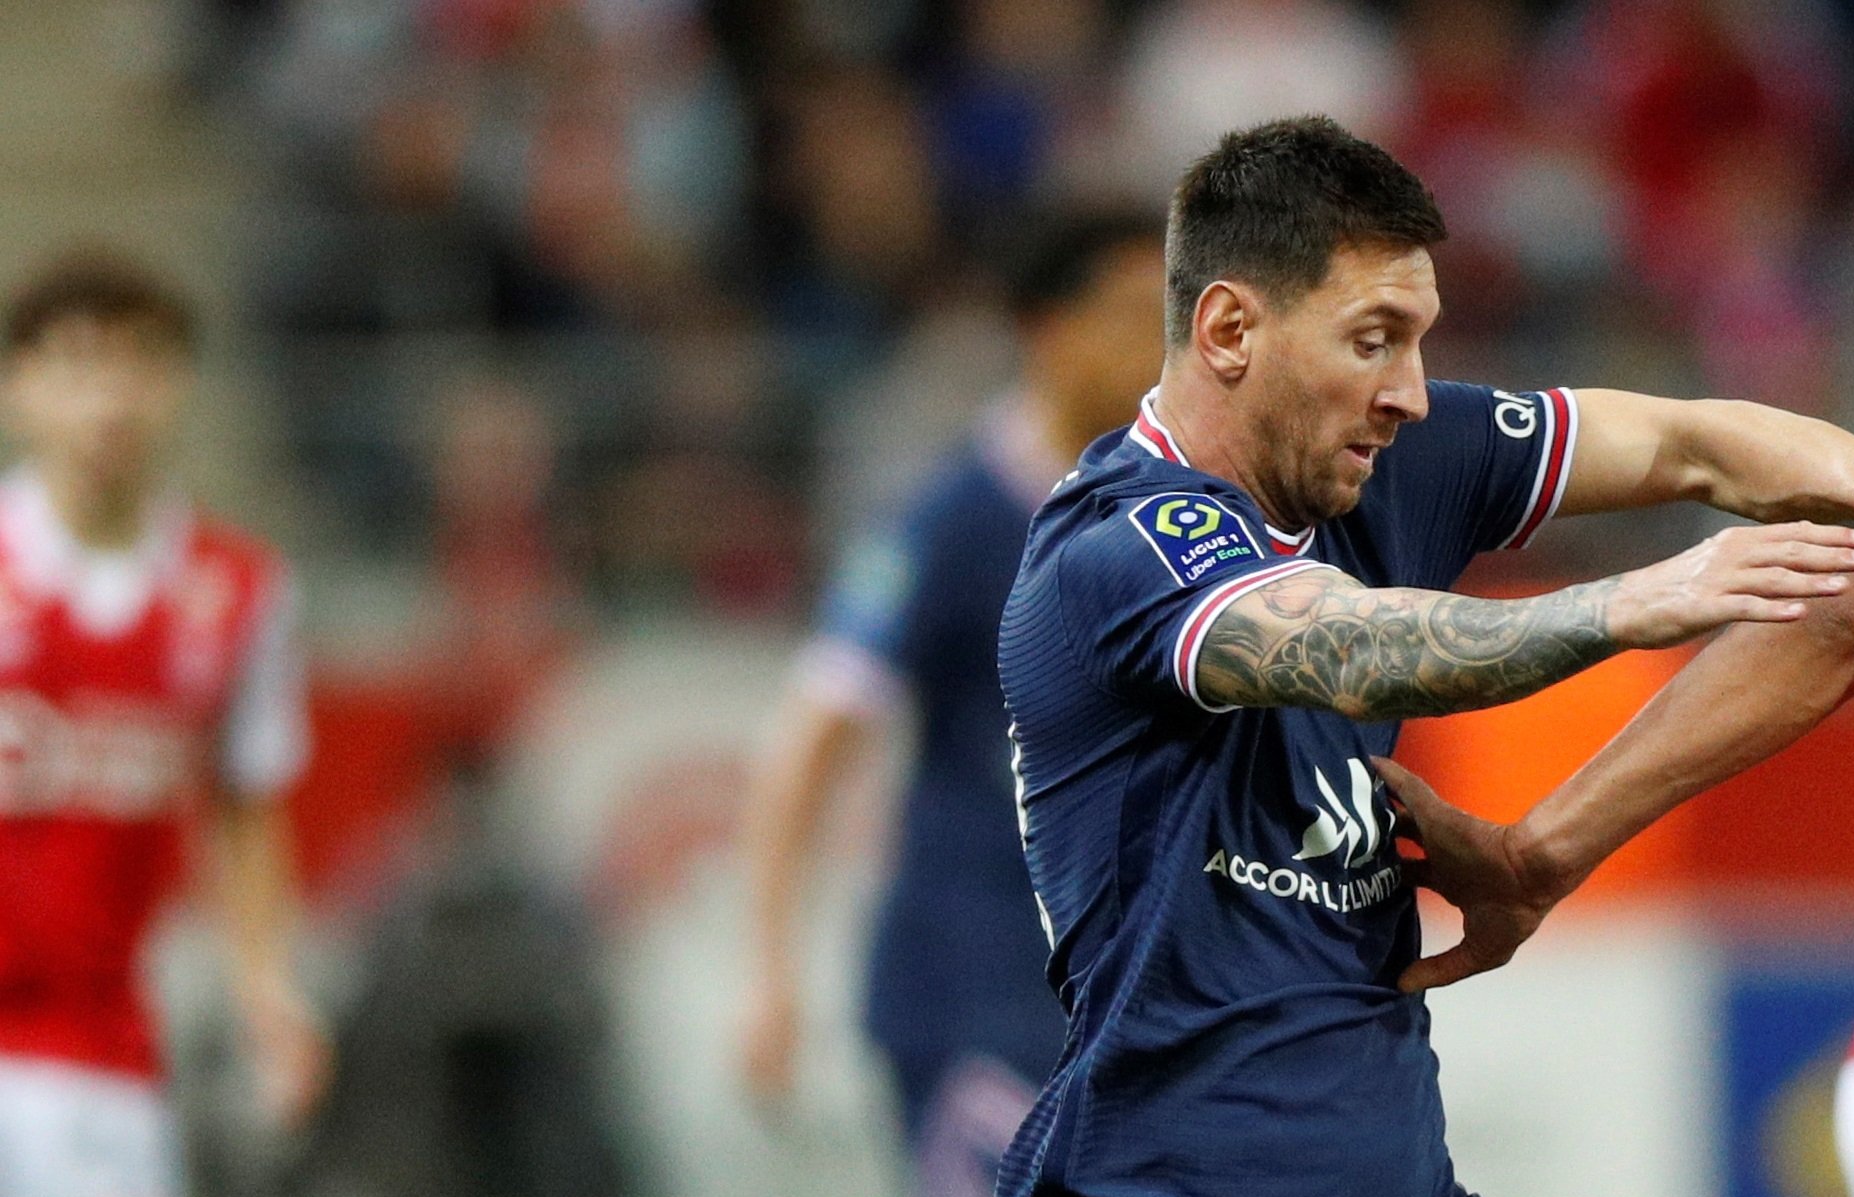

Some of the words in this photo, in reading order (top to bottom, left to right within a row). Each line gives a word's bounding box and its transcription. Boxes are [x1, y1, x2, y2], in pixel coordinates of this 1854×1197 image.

[1180, 535, 1229, 566] LIGUE
[1229, 533, 1240, 543] 1
[1185, 555, 1218, 581] Uber
[1216, 546, 1252, 561] Eats
